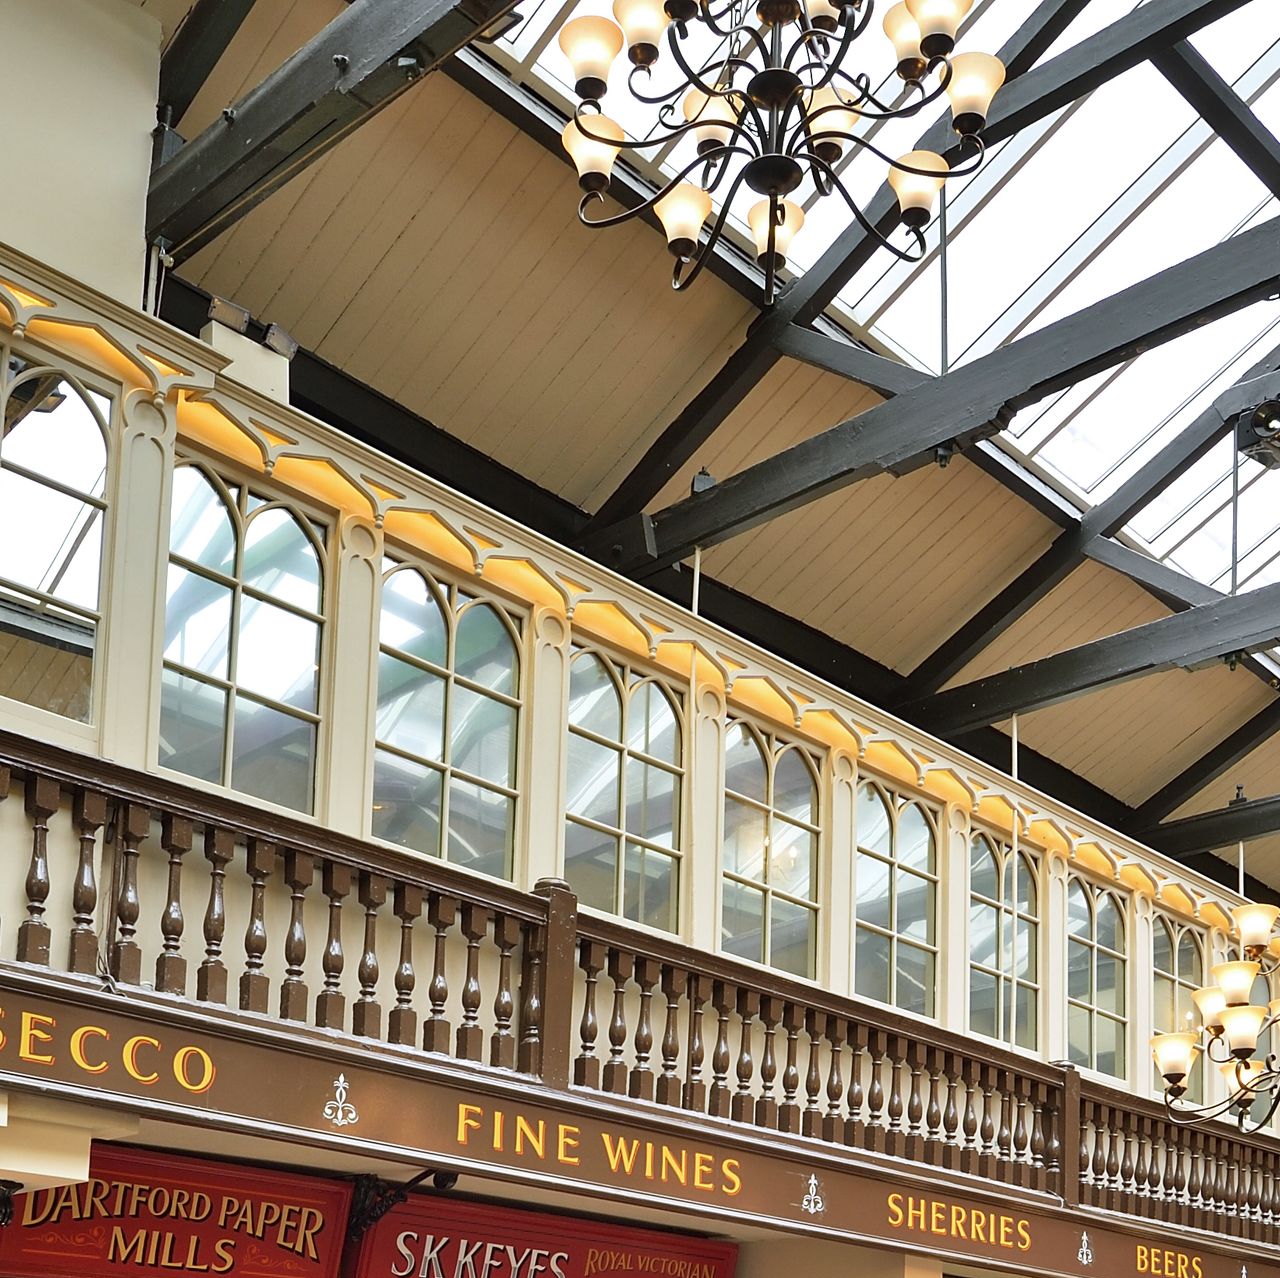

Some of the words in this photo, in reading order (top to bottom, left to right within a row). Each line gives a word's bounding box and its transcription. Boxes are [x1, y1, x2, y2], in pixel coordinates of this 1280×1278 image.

[455, 1103, 582, 1165] FINE
[601, 1132, 743, 1196] WINES
[21, 1179, 212, 1226] DARTFORD
[217, 1196, 325, 1261] PAPER
[107, 1225, 238, 1273] MILLS
[887, 1193, 1032, 1252] SHERRIES
[584, 1248, 634, 1277] ROYAL
